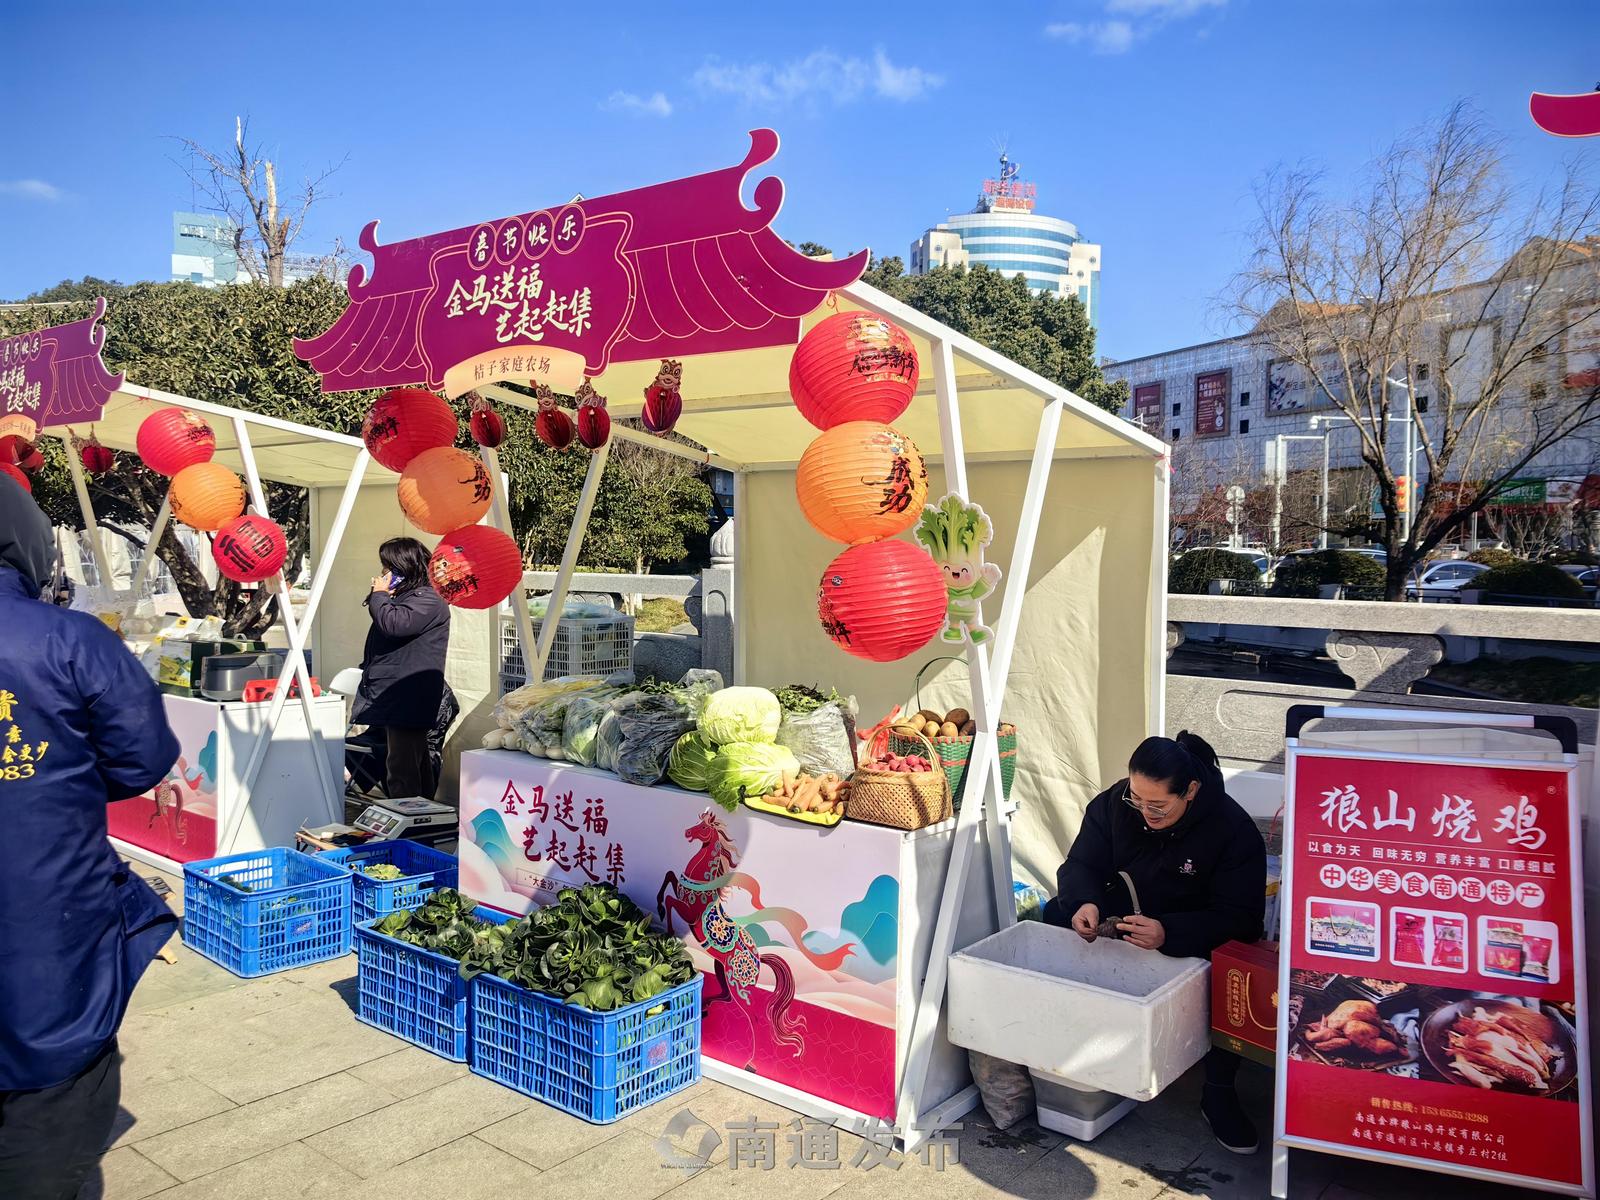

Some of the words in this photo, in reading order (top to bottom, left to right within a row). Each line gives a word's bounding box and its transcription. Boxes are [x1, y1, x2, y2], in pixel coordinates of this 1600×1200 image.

[473, 214, 577, 262] 春节快乐
[443, 262, 544, 318] 金马送福
[495, 286, 593, 343] 艺起赶集
[473, 355, 551, 382] 桔子家庭农场
[500, 779, 609, 837] 金马送福
[1319, 784, 1547, 850] 狼山烧鸡
[522, 825, 626, 887] 艺起赶集
[1308, 841, 1361, 858] 以食为天
[1373, 847, 1428, 863] 回味无穷
[1435, 852, 1491, 869] 营养丰富
[1499, 858, 1556, 875] 口感细腻
[1322, 866, 1543, 903] 中华美食南通特产
